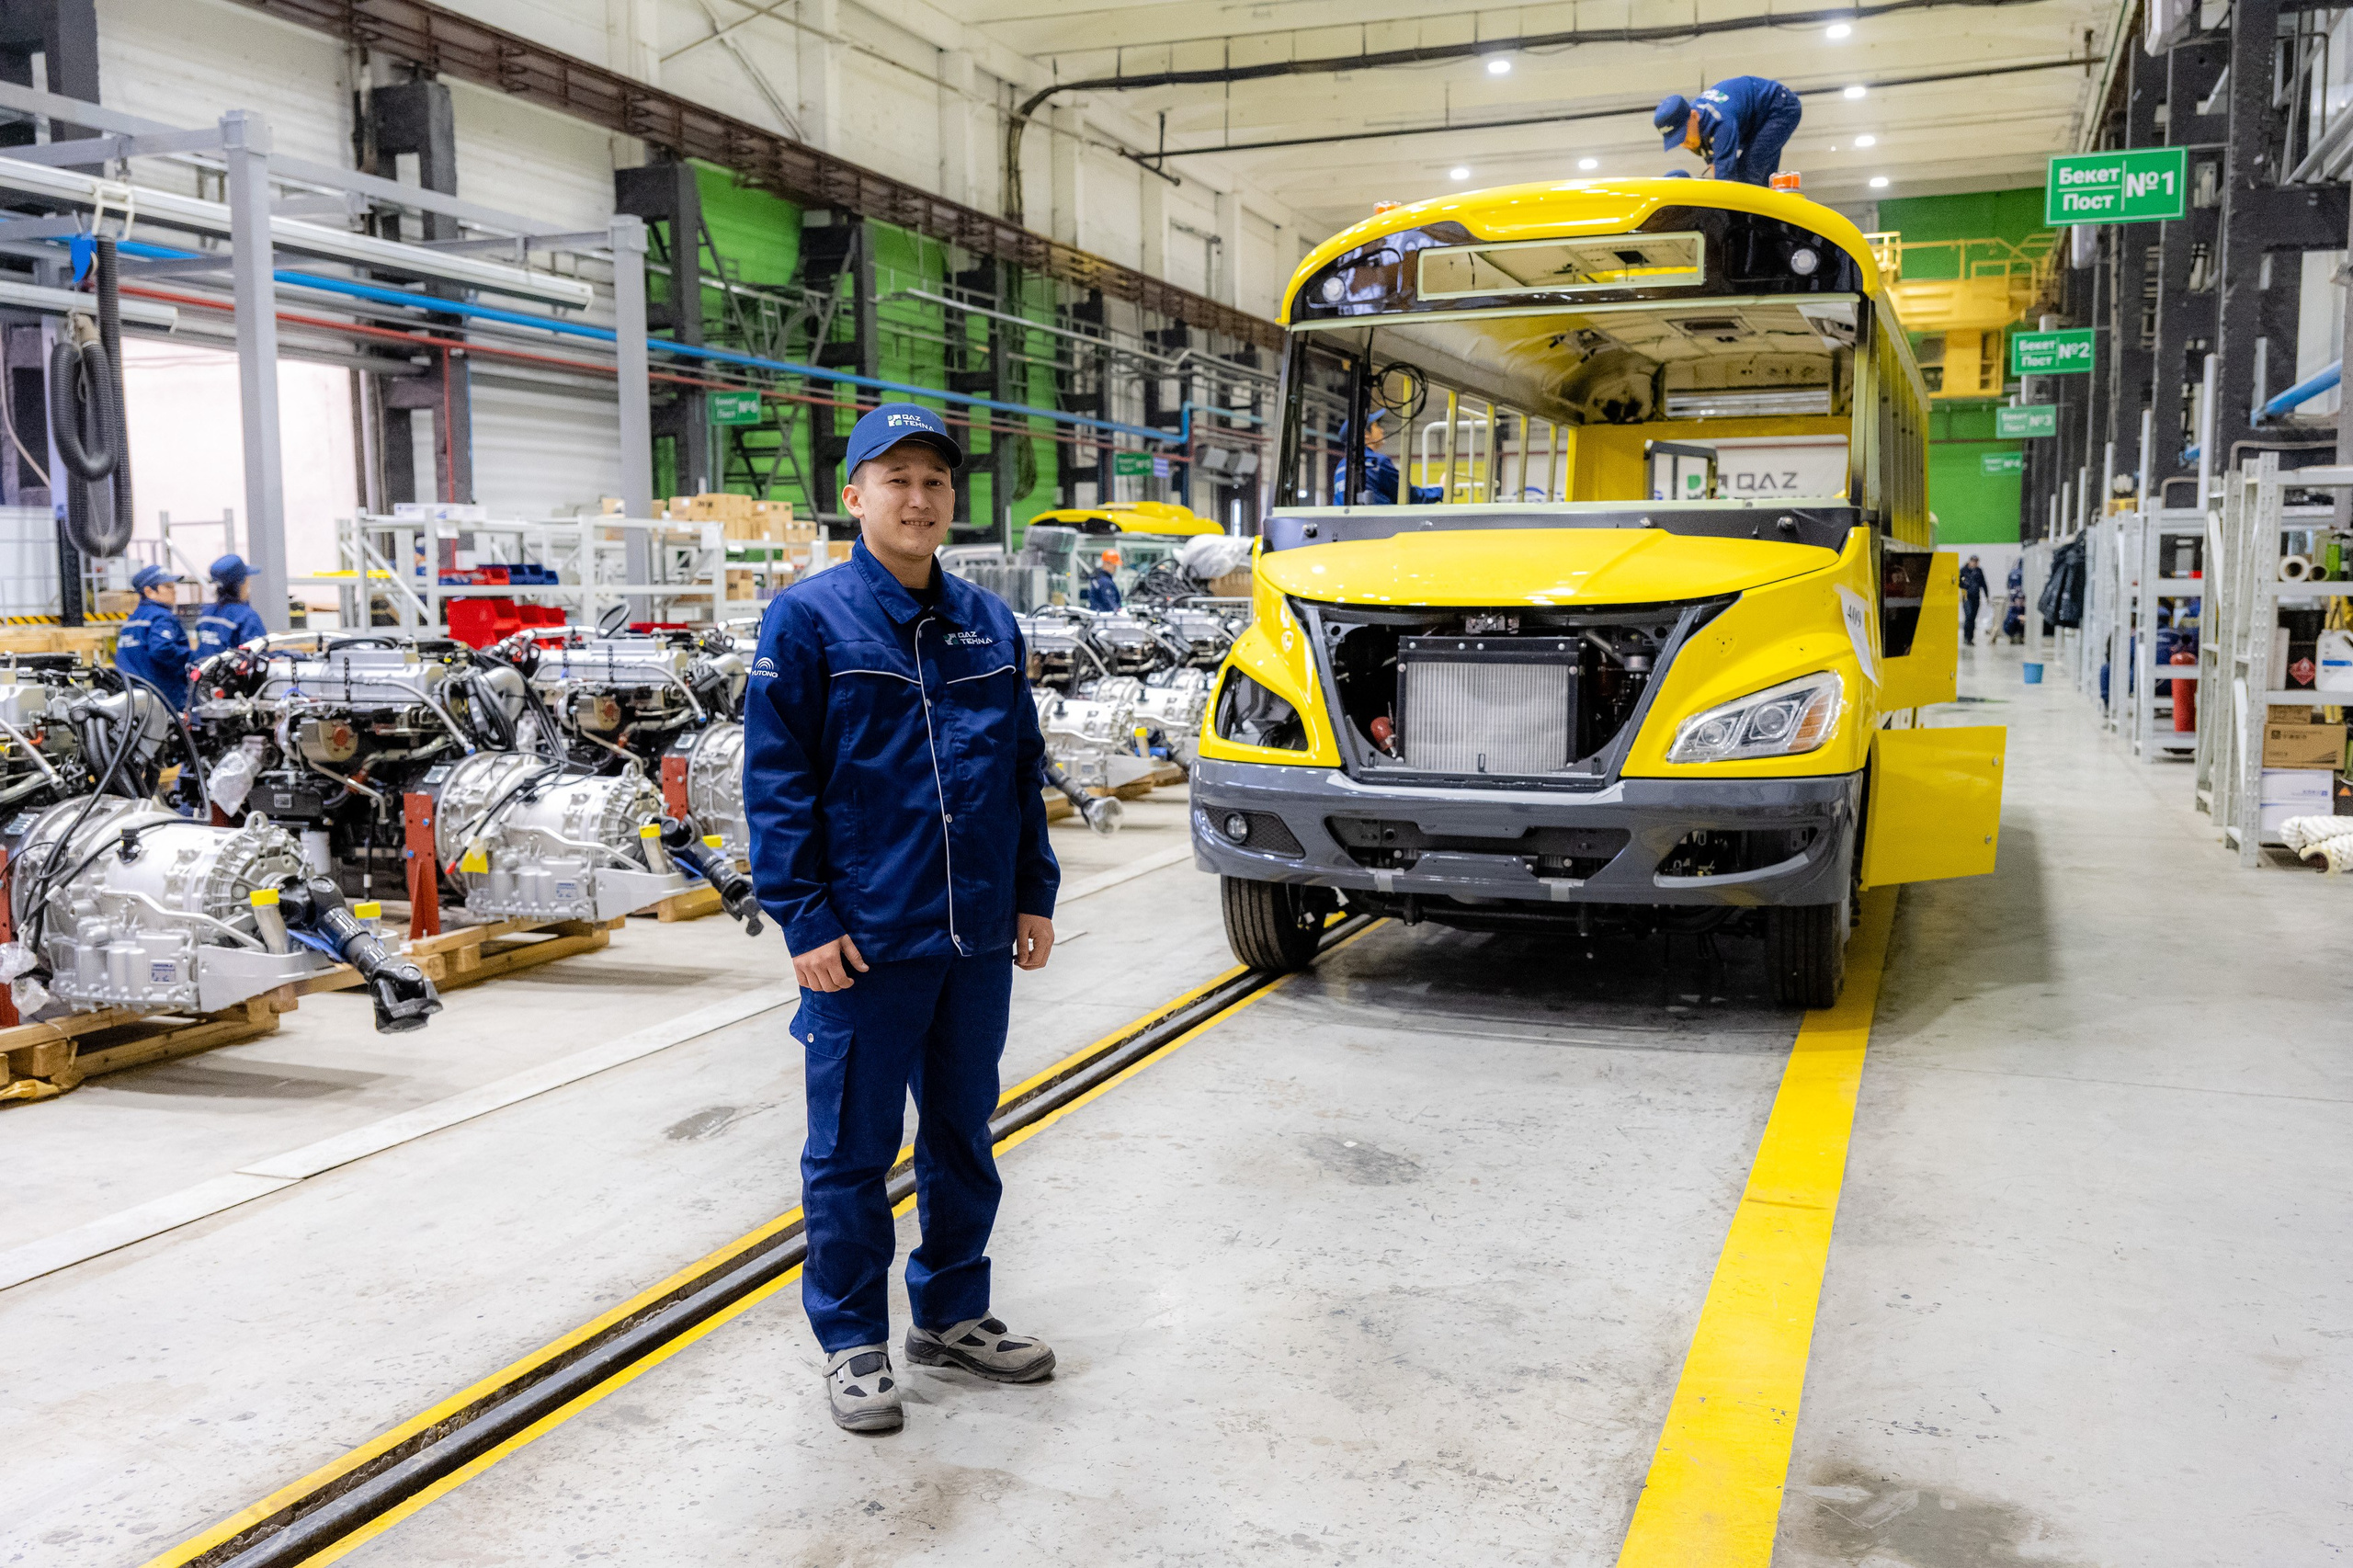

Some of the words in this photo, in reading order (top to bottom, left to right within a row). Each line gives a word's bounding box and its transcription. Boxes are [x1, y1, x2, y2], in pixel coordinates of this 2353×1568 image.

[2059, 166, 2120, 185] Бекет
[2126, 170, 2175, 198] №1
[2063, 193, 2114, 211] Пост
[2018, 339, 2055, 351] Бекет
[2059, 341, 2090, 359] №2
[2021, 355, 2052, 367] Пост
[902, 414, 921, 422] QAZ
[903, 419, 935, 431] TEHNA
[1736, 471, 1798, 492] QAZ
[1847, 605, 1862, 628] 409
[957, 631, 977, 639] QAZ
[960, 637, 993, 645] TEHNA
[751, 670, 779, 678] YUTONG
